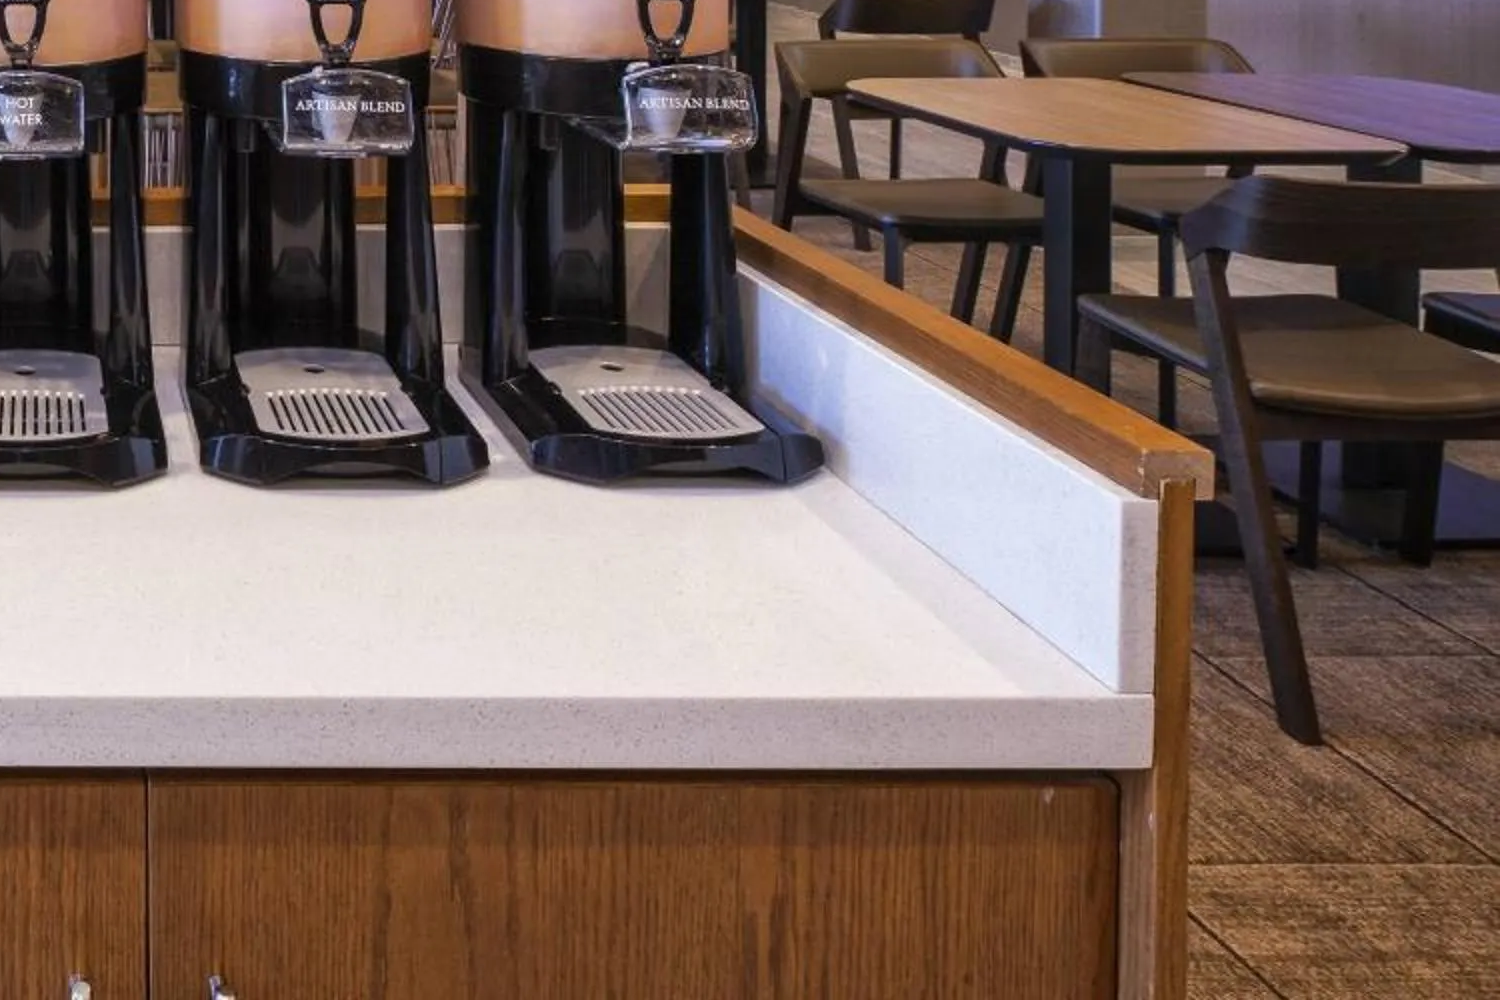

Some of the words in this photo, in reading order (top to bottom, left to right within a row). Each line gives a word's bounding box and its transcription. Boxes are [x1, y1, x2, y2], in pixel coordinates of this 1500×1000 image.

[5, 97, 34, 109] HOT
[295, 100, 358, 111] ARTISAN
[361, 101, 405, 113] BLEND
[639, 98, 703, 109] ARTISAN
[705, 98, 750, 110] BLEND
